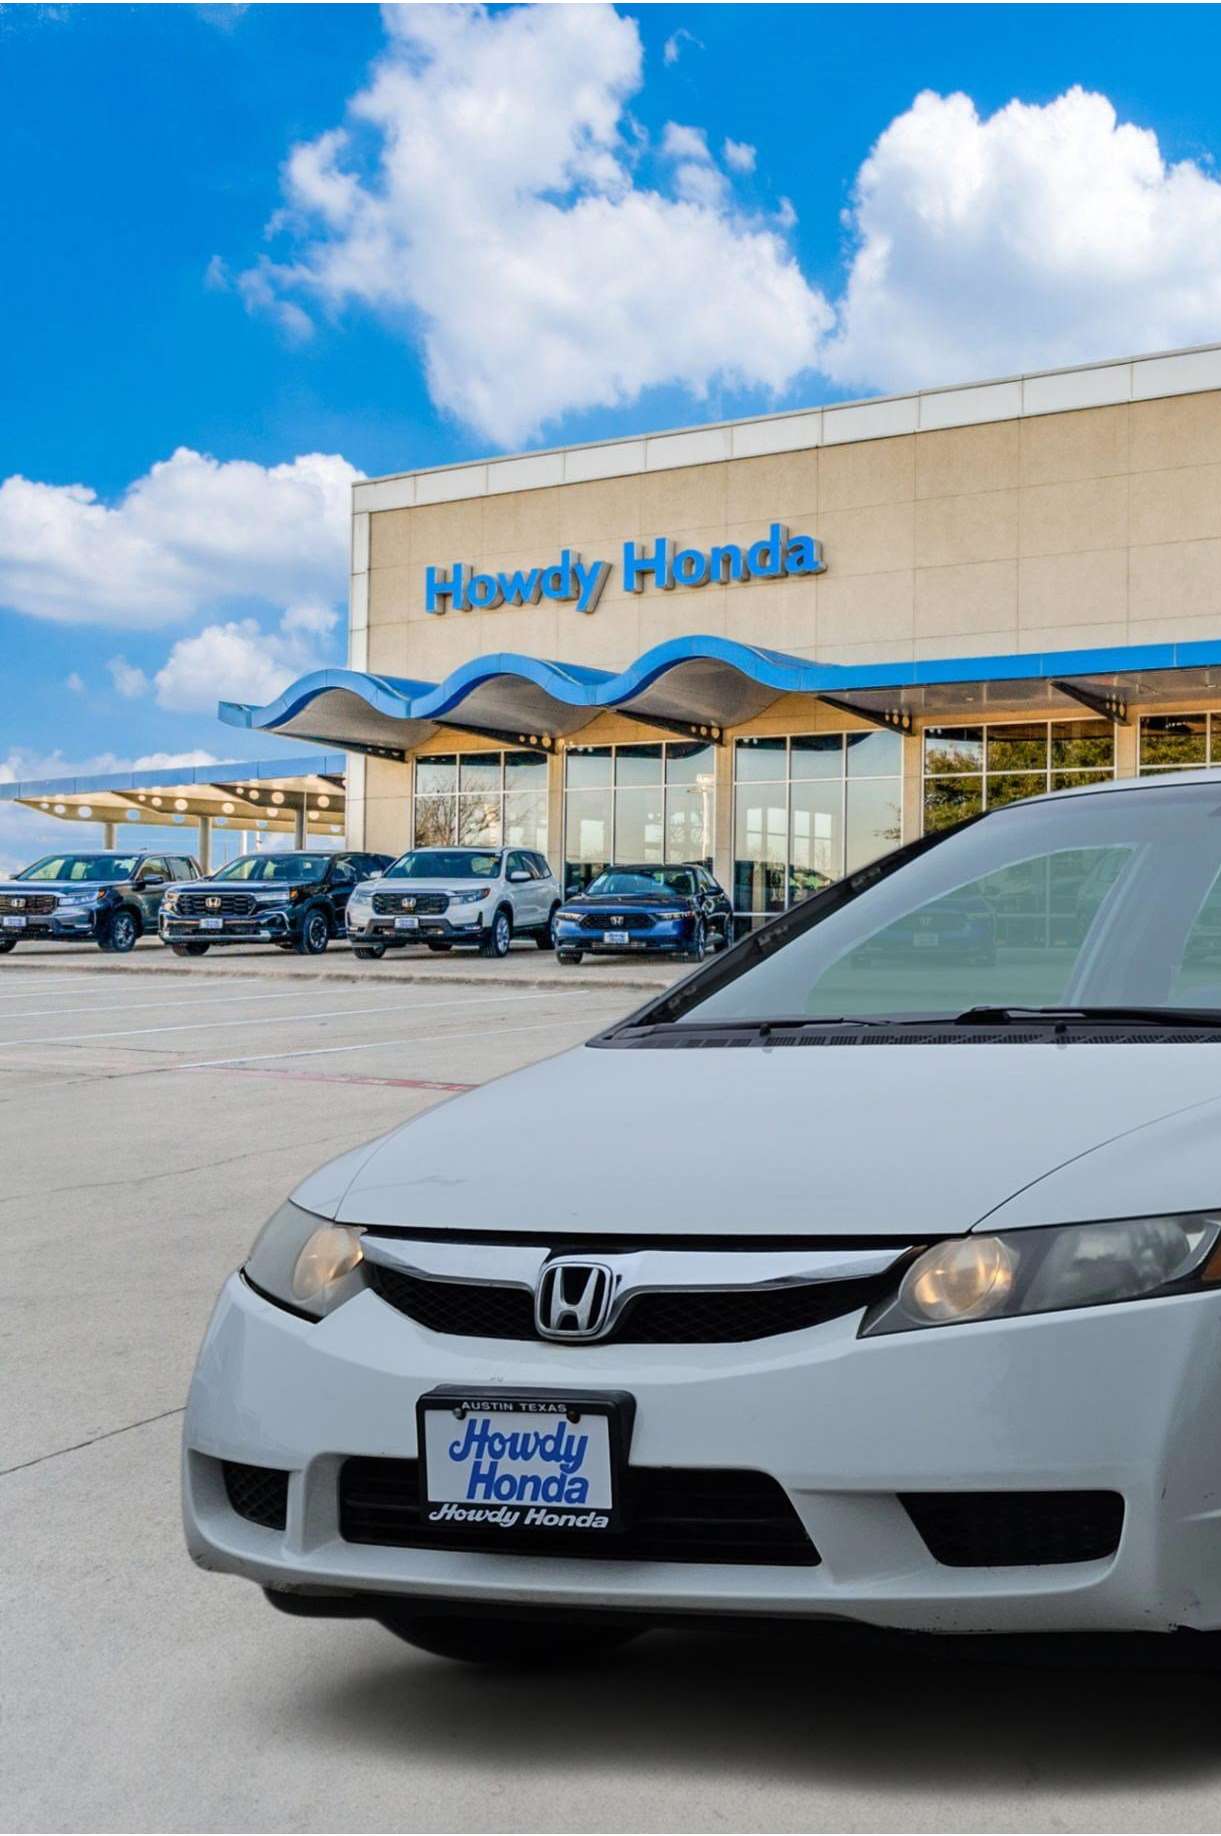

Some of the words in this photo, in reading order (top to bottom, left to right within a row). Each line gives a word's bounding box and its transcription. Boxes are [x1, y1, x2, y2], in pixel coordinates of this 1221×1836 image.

[425, 549, 611, 614] Howdy
[623, 523, 826, 593] Honda
[461, 1401, 513, 1411] AUSTIN
[519, 1402, 567, 1412] TEXAS
[449, 1418, 588, 1474] Howdy
[466, 1461, 589, 1504] Honda
[428, 1503, 520, 1528] Howdy
[524, 1508, 609, 1528] Honda
